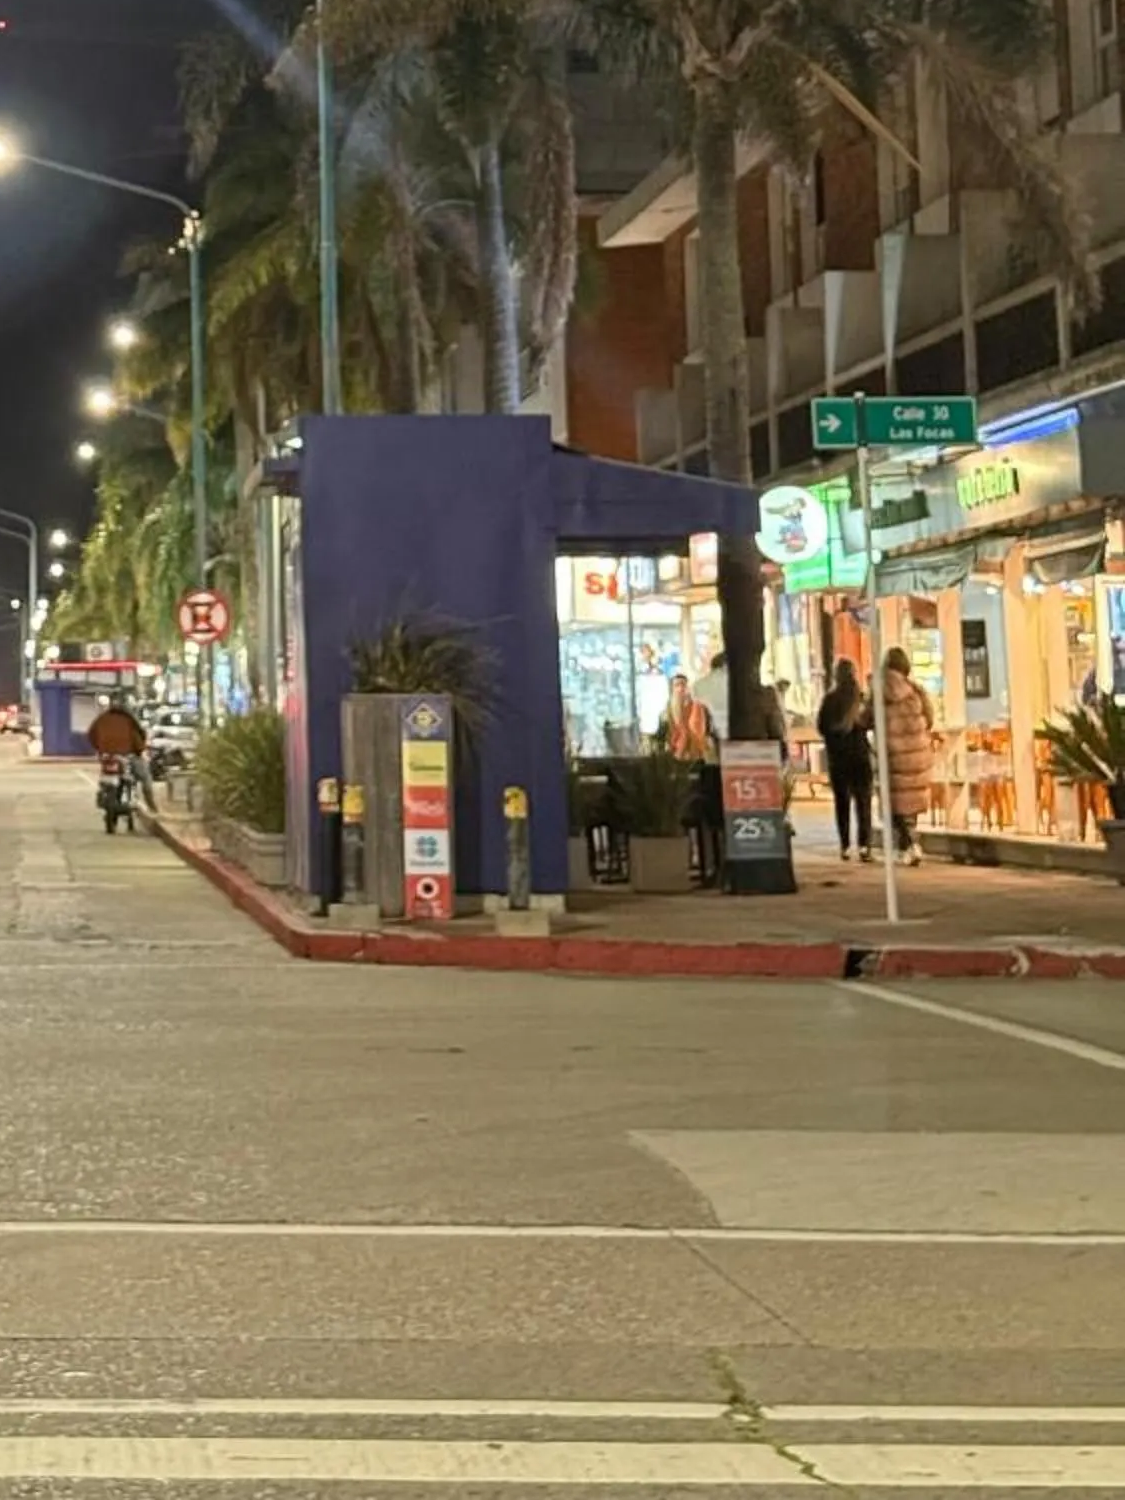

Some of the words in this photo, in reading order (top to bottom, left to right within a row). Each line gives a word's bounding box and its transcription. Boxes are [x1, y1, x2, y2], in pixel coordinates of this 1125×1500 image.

[893, 405, 925, 420] Calle
[890, 426, 913, 439] Las
[917, 426, 955, 439] Focas
